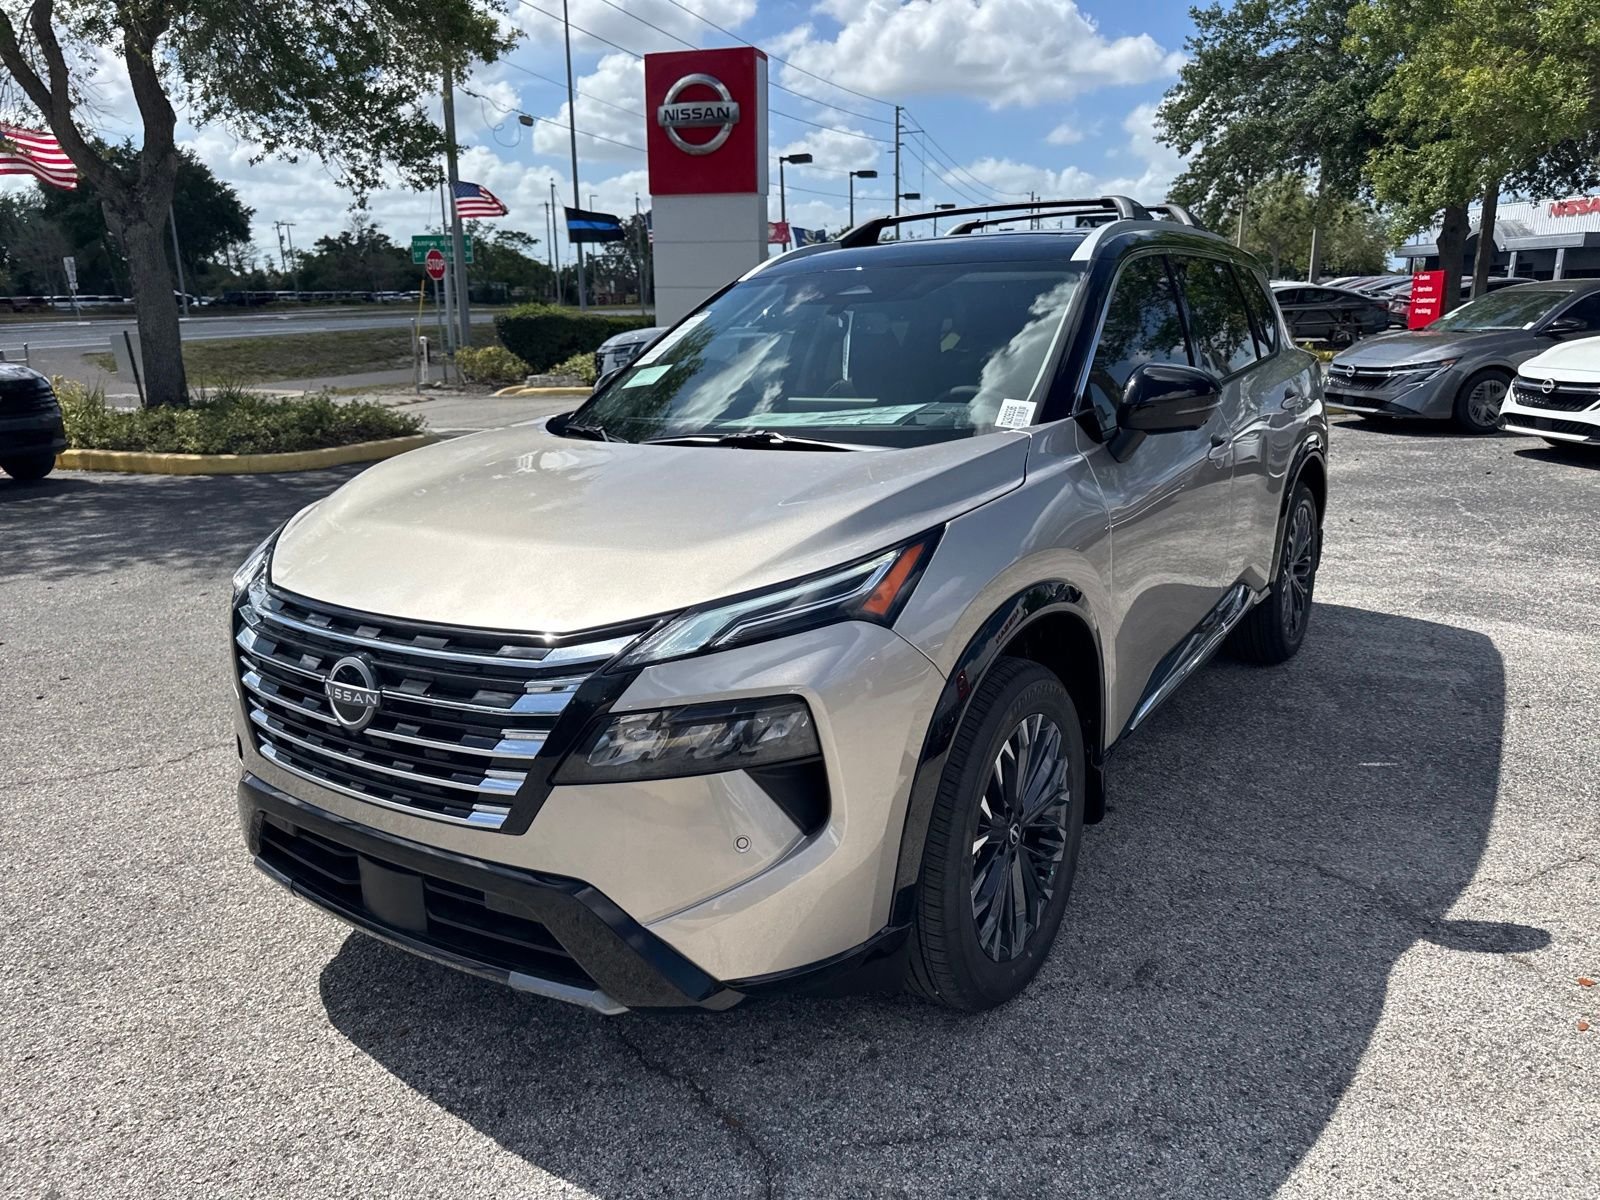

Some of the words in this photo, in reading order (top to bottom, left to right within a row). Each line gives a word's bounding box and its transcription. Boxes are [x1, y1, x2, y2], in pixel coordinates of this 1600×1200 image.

[664, 106, 730, 122] NISSAN
[428, 259, 444, 270] STOP
[326, 683, 377, 704] NISSAN
